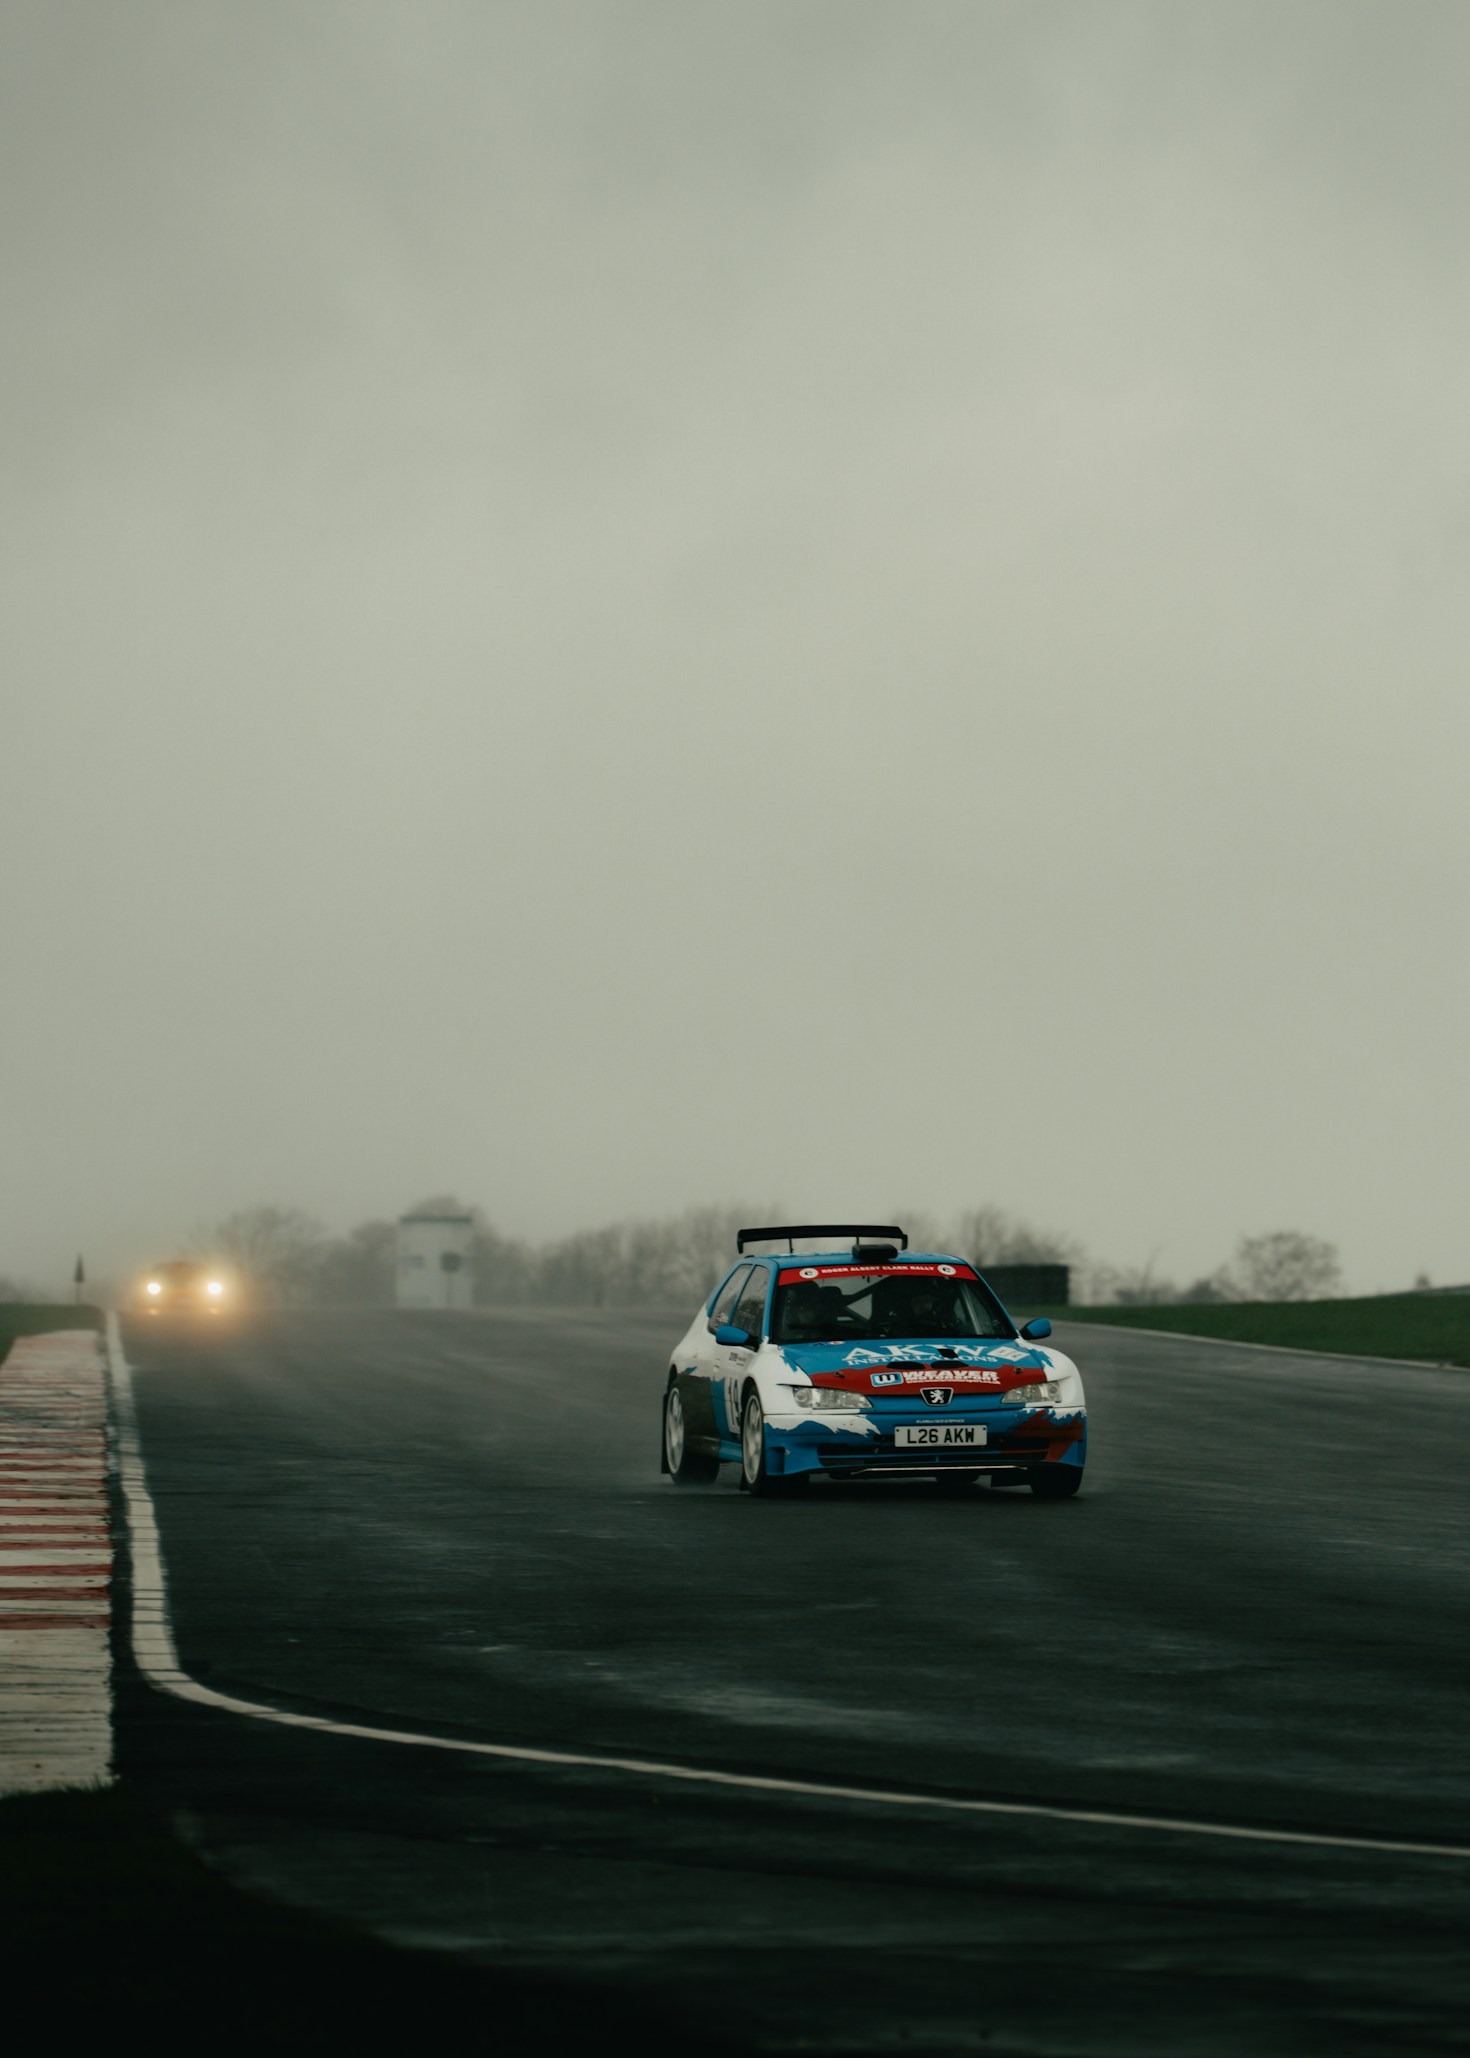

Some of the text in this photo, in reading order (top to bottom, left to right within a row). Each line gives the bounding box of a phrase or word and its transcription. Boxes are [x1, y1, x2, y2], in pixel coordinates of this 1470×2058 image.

[902, 1370, 997, 1378] WEAVER
[907, 1427, 975, 1444] L26 AKW
